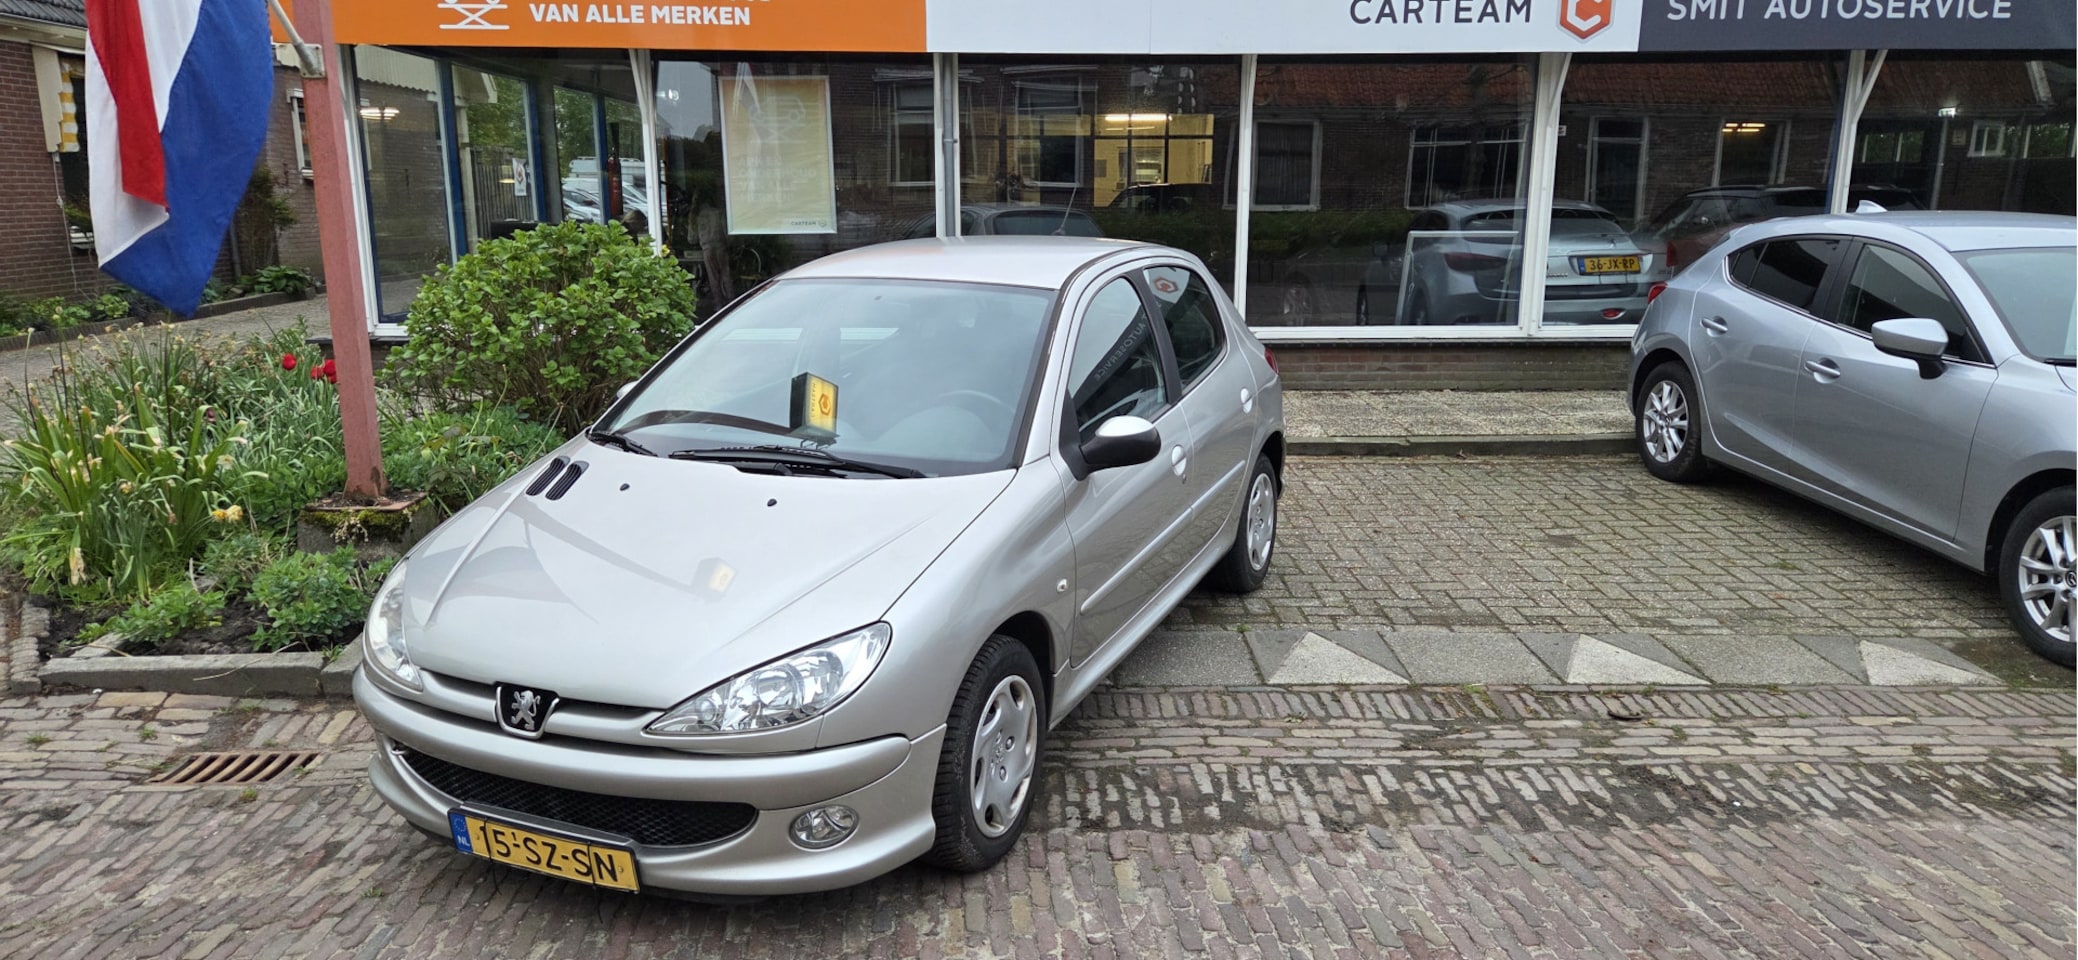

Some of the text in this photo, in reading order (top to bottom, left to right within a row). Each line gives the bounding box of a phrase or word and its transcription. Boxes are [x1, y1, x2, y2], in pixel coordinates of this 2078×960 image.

[529, 4, 750, 25] VAN ALLE MERKEN
[1350, 0, 1530, 24] CARTEAM
[1667, 0, 2012, 20] SMIT AUTOSERVICE
[1590, 259, 1635, 270] 36-JX-RP
[457, 835, 470, 847] NL
